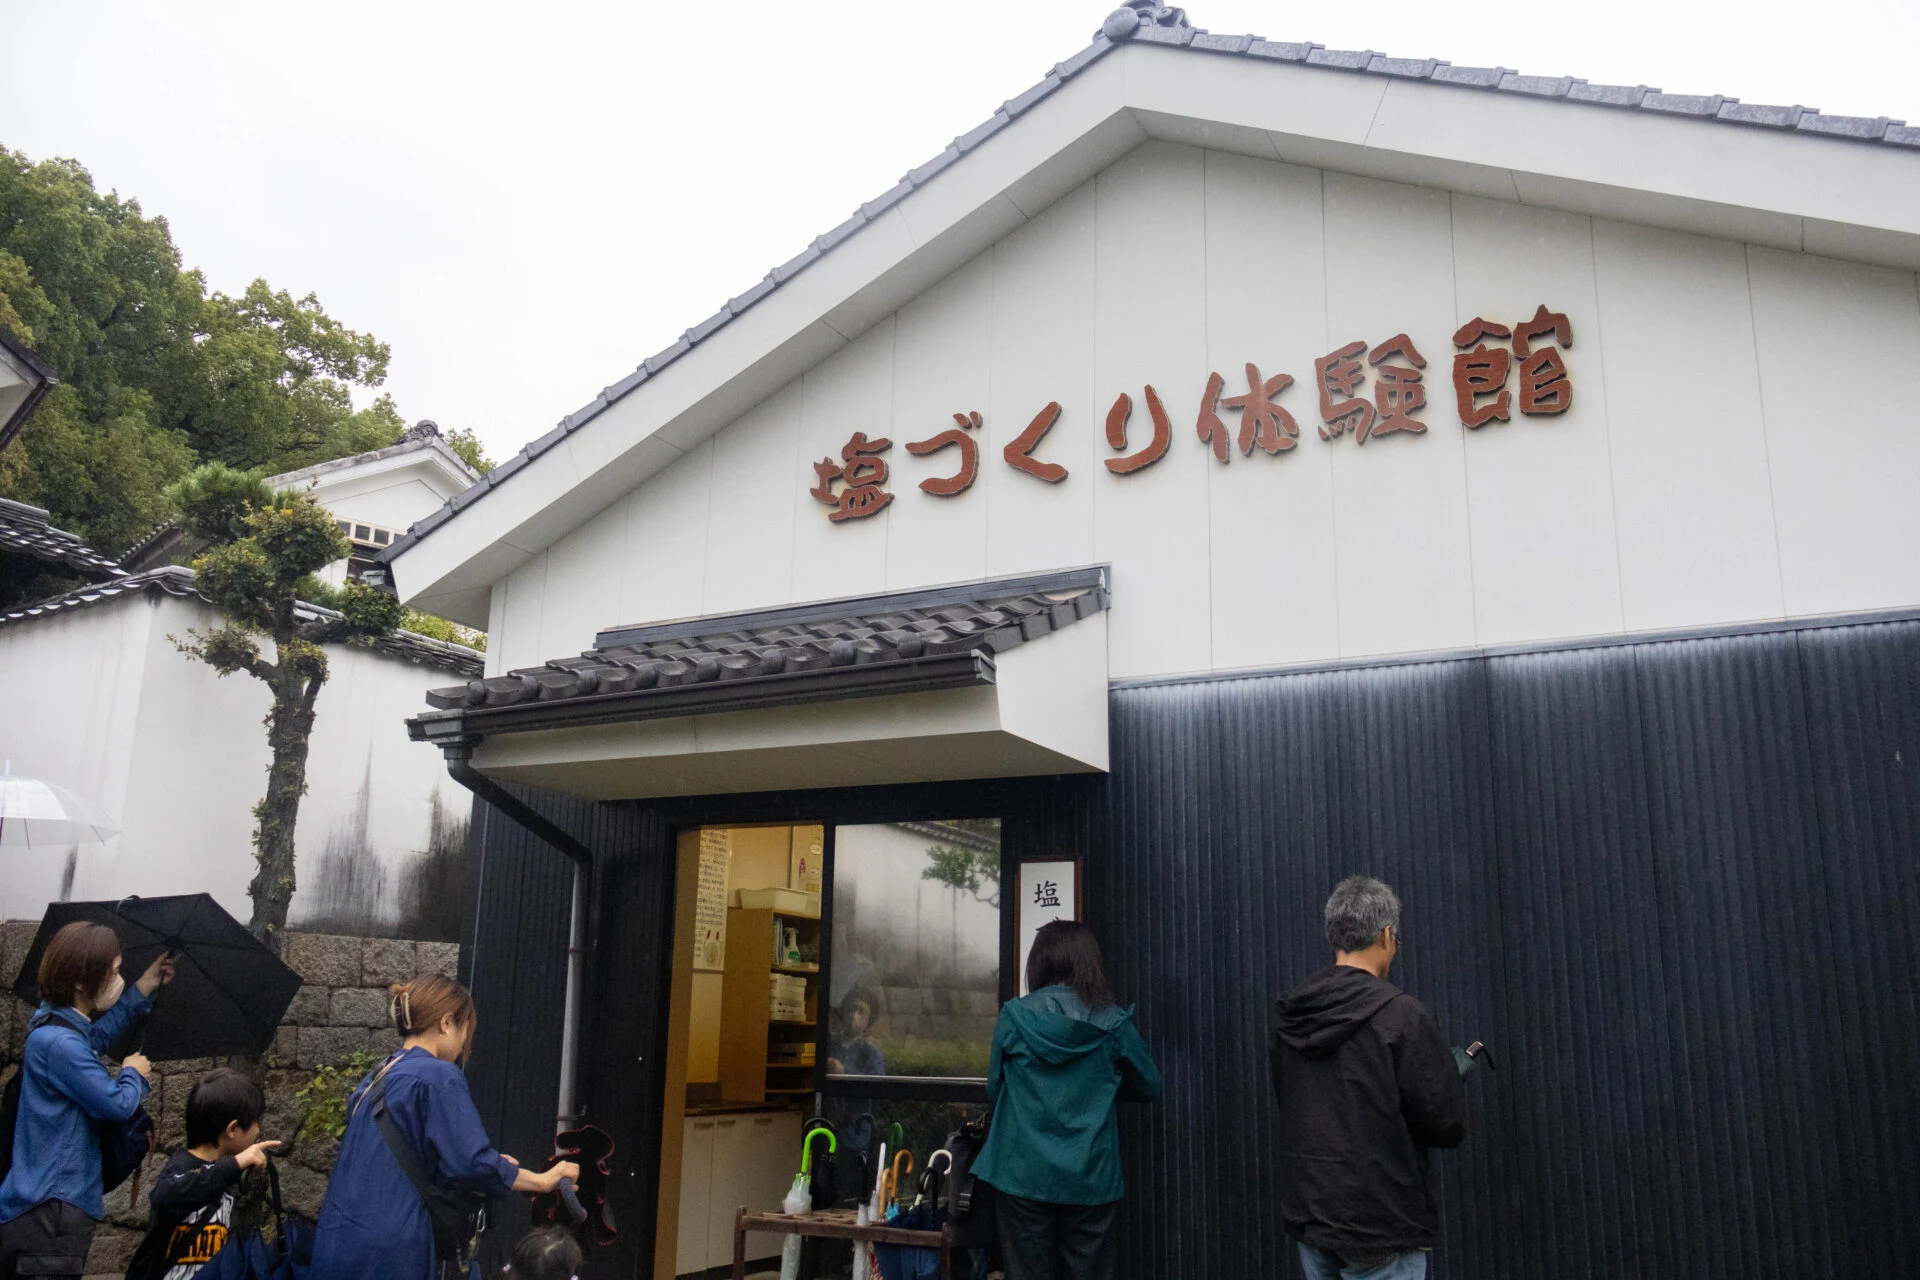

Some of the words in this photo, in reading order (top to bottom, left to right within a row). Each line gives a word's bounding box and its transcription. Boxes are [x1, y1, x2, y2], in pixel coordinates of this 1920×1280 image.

[811, 305, 1573, 523] 塩づくり体験館
